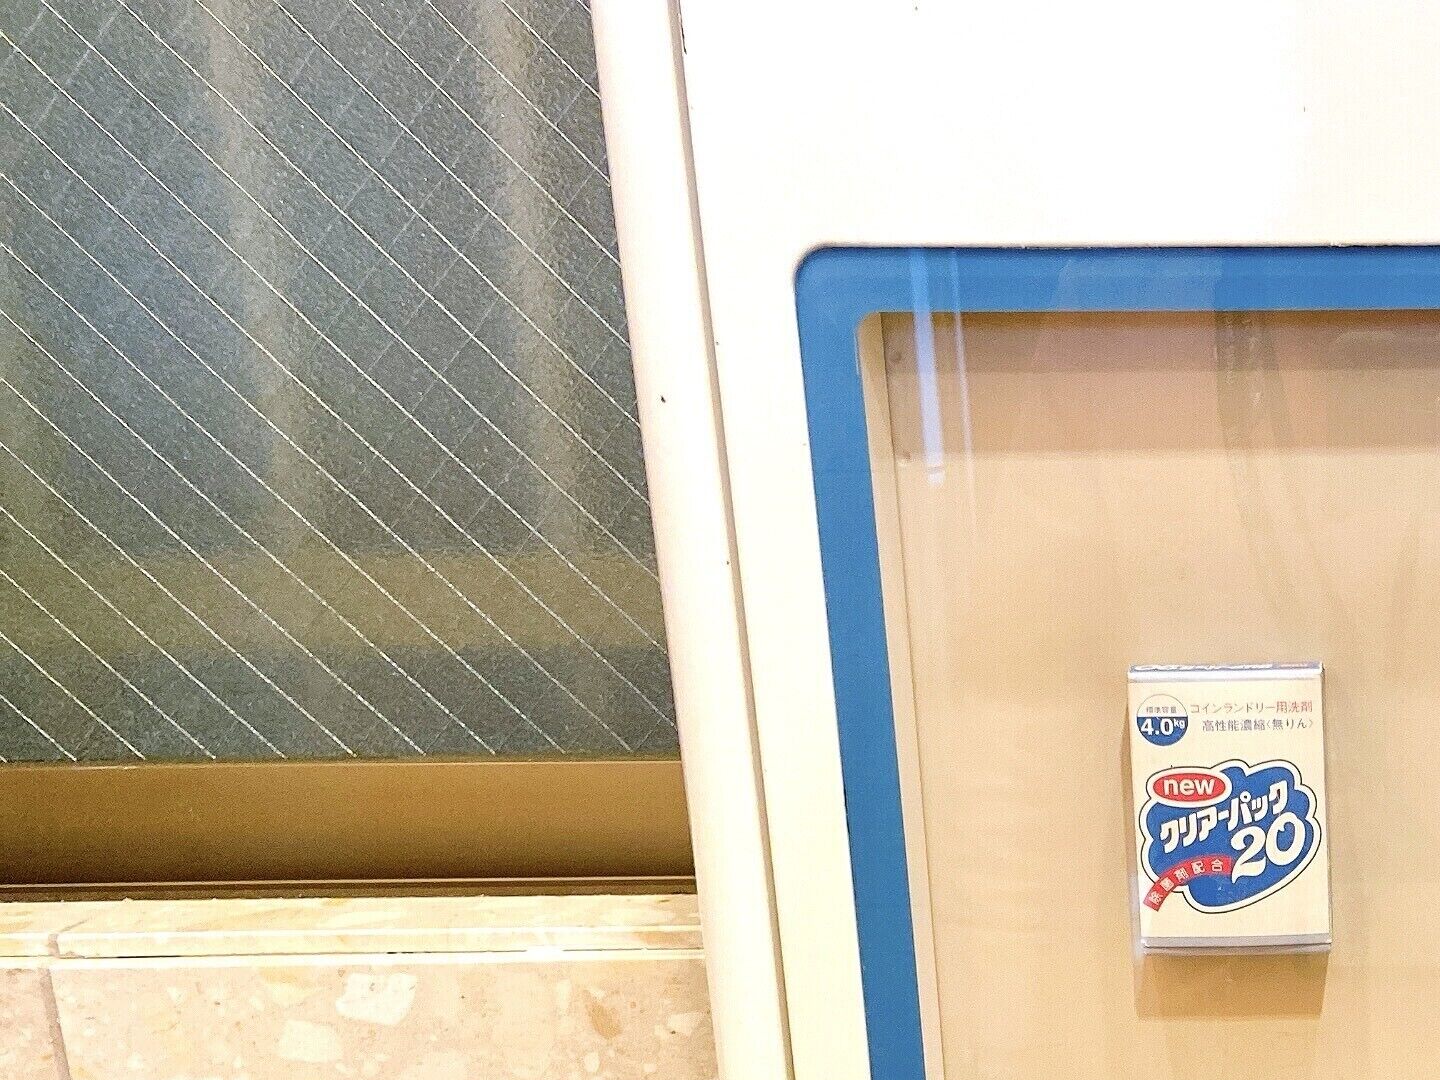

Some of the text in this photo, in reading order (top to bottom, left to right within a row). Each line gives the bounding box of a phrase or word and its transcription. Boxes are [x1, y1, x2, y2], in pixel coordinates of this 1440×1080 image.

[1159, 780, 1289, 854] クリアーパック
[1163, 775, 1218, 797] new
[1230, 811, 1307, 884] 20
